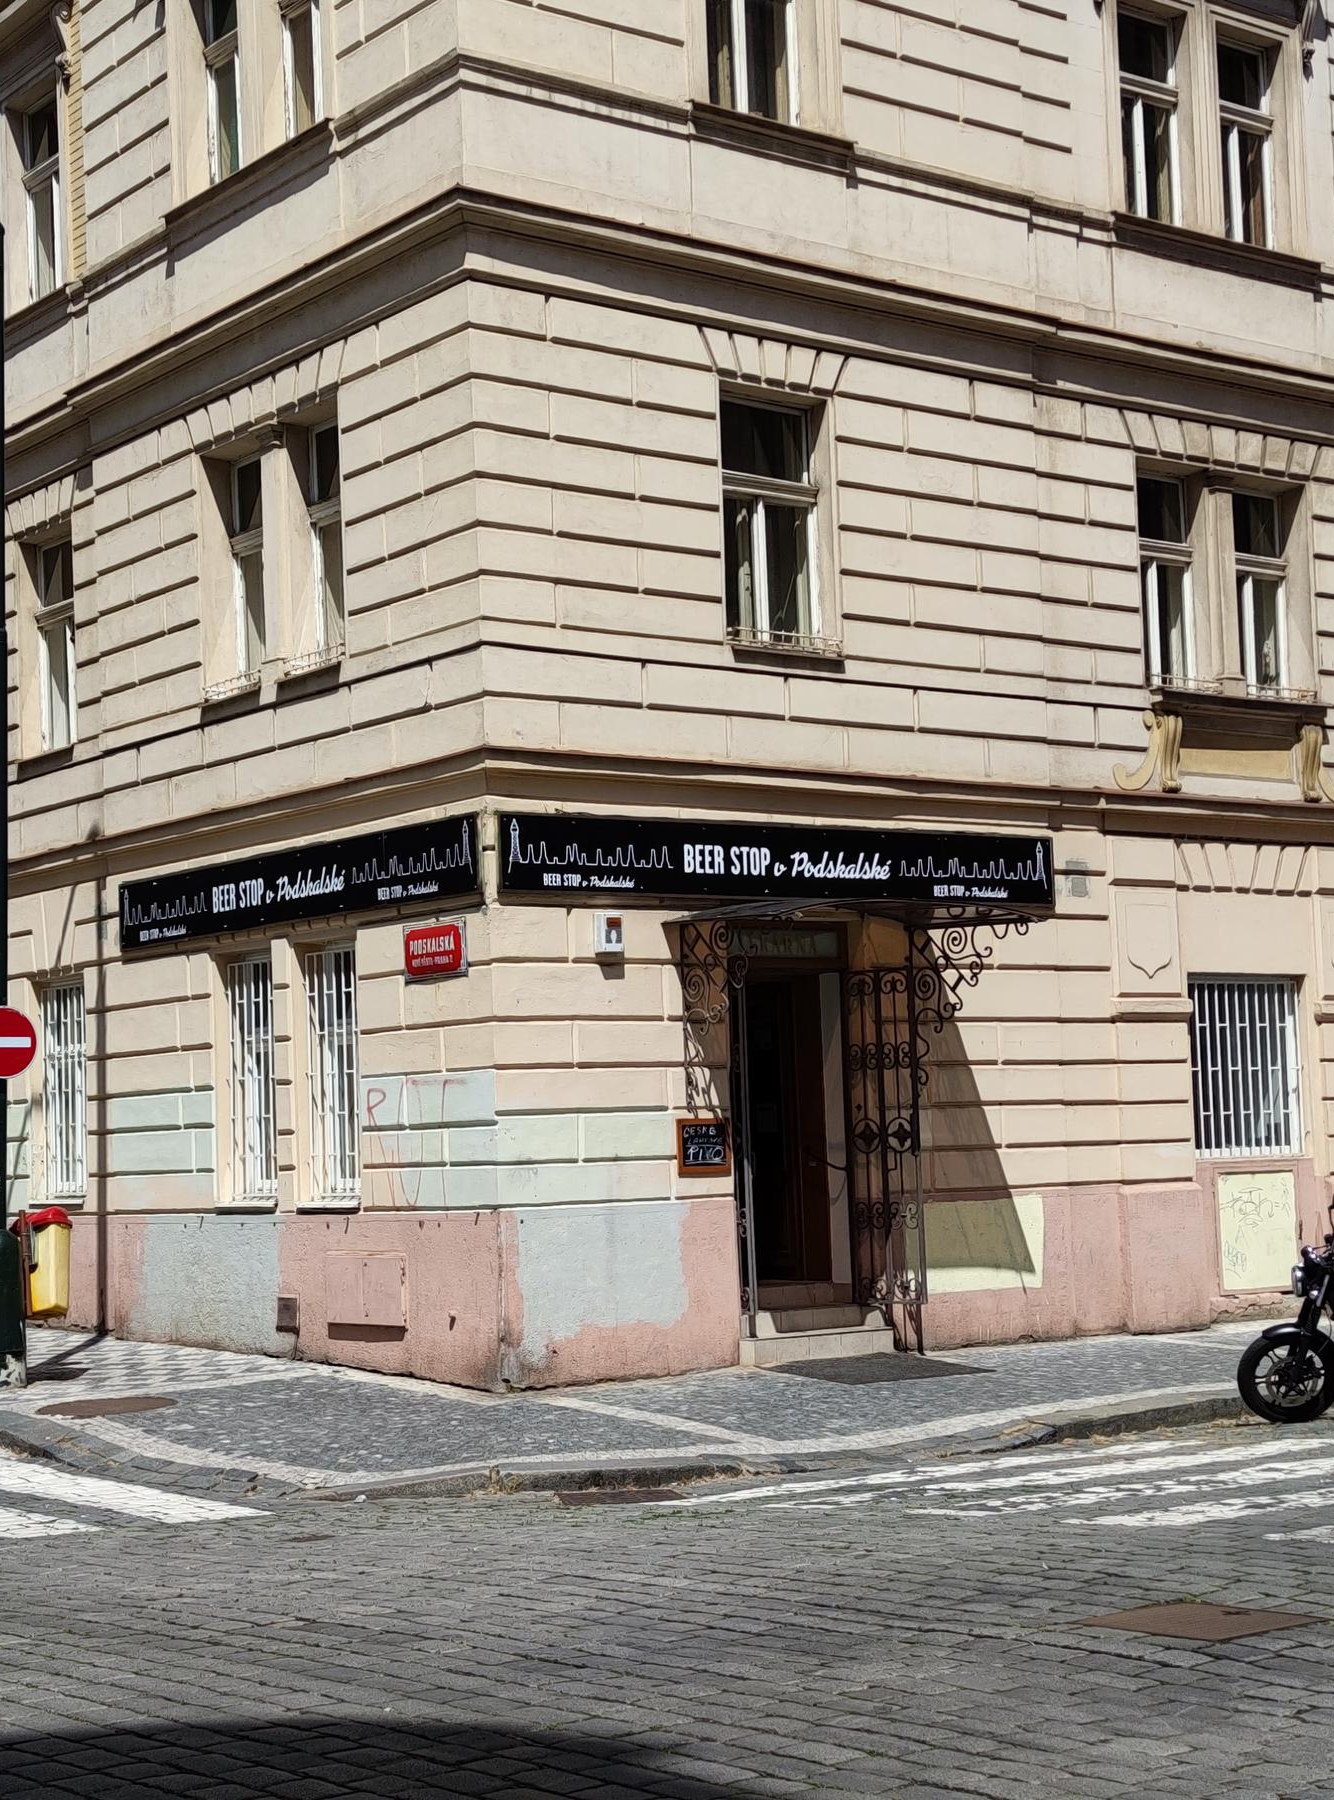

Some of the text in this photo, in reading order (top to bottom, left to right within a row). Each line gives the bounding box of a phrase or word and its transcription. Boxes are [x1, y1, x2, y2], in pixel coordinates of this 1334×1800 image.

[683, 844, 892, 880] BEER STOP v Podskalské
[212, 864, 346, 913] BEER STOP v Podskalské
[543, 873, 562, 886] BEER
[563, 874, 581, 887] STOP
[589, 875, 635, 888] Podskalské
[377, 887, 390, 900] BEER
[391, 885, 402, 899] STOP
[933, 885, 948, 896] BEER
[950, 885, 965, 897] STOP
[409, 930, 455, 956] PODSKALSKÁ
